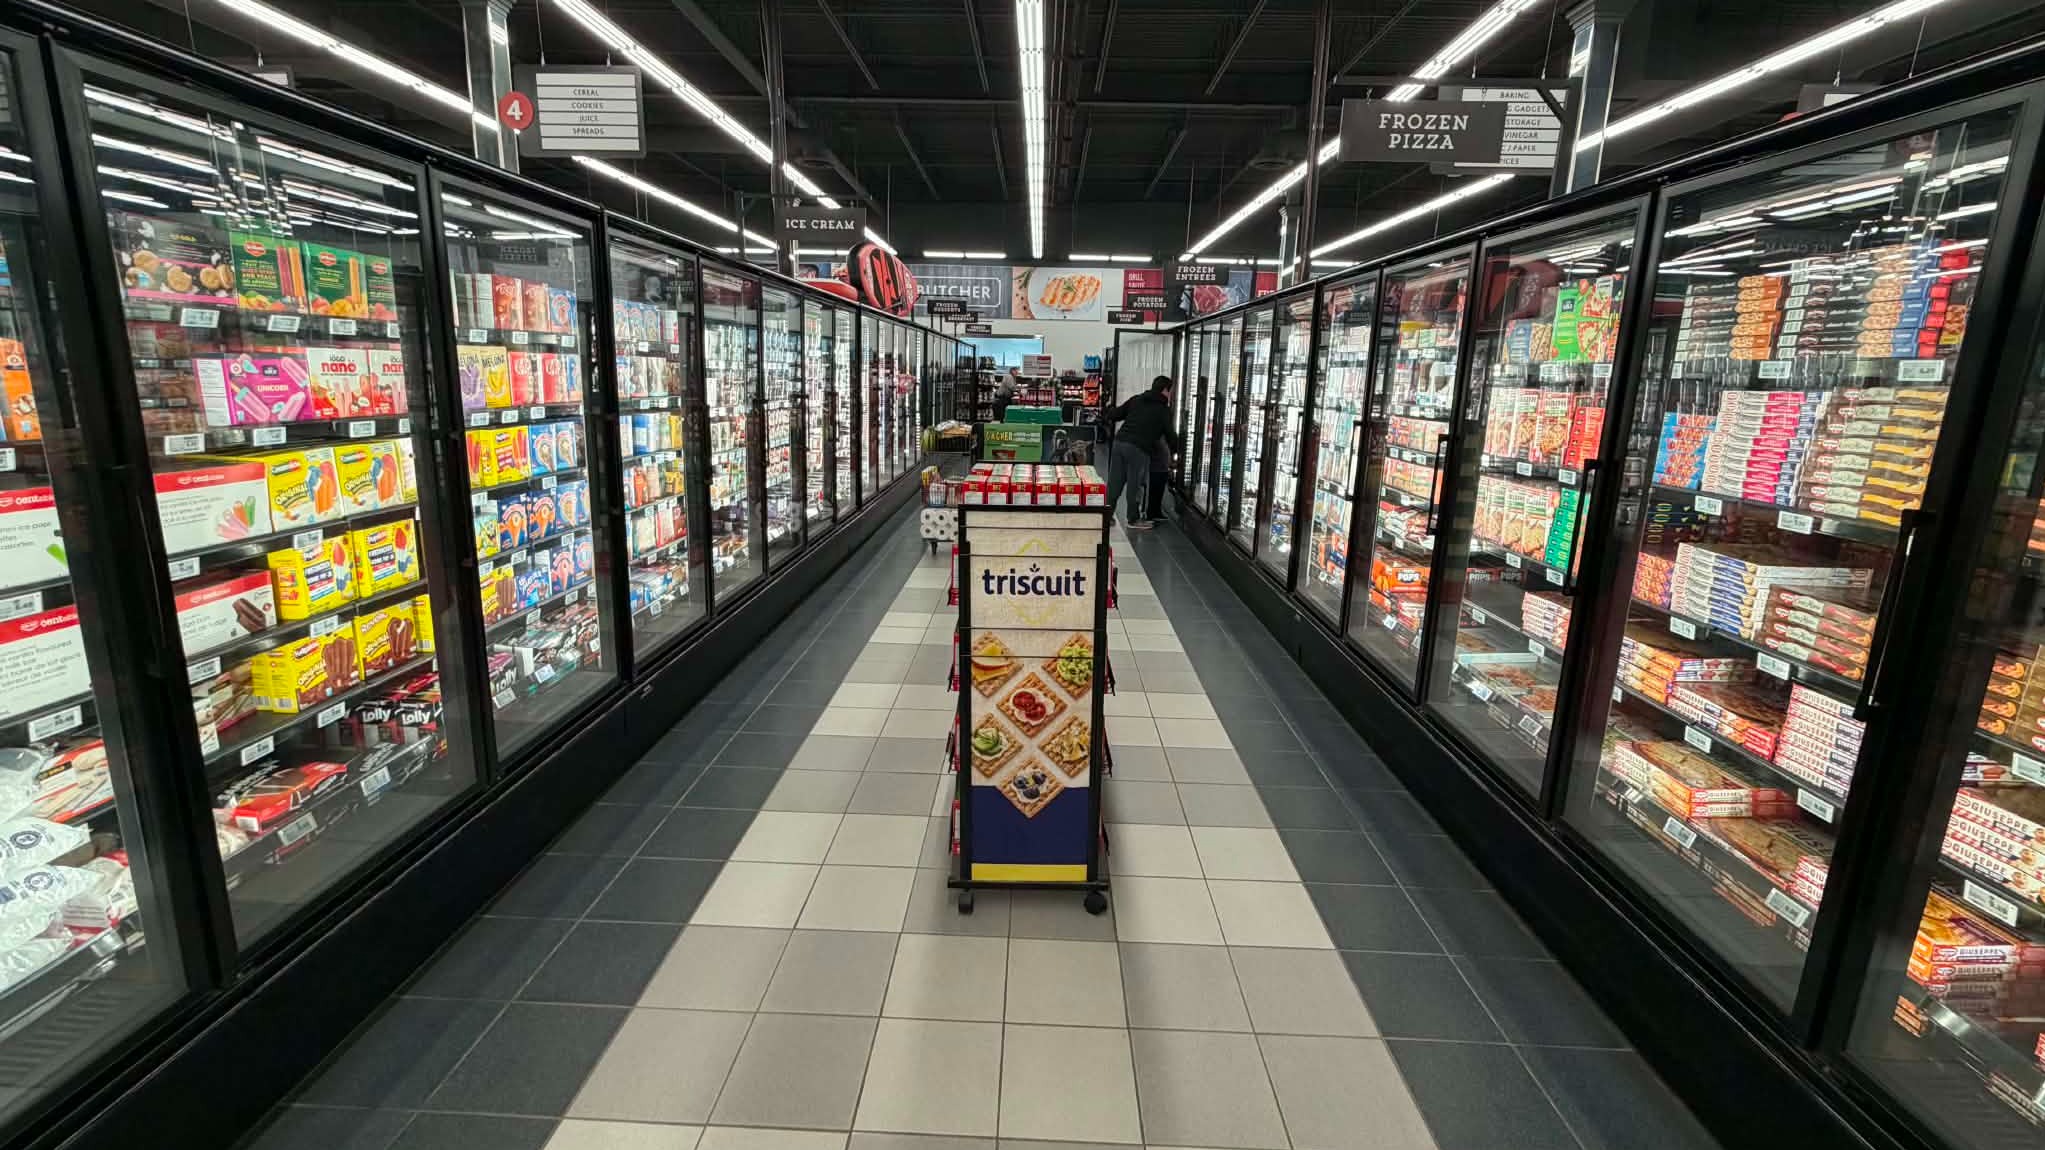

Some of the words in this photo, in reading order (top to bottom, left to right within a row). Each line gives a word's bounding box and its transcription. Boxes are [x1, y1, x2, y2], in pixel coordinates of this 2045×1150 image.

[572, 88, 600, 96] CEREAL
[1499, 91, 1529, 99] BAKING
[506, 99, 523, 121] 4
[571, 102, 604, 110] COOKIES
[1378, 113, 1469, 130] FROZEN
[572, 127, 605, 135] SPREADS
[1388, 133, 1455, 150] PIZZA
[785, 219, 807, 229] ICE
[811, 219, 855, 230] CREAM
[1177, 265, 1215, 274] FROZEN
[916, 285, 991, 299] BUTCHER
[982, 568, 1087, 596] triscuit
[362, 707, 391, 723] Lolly
[401, 710, 431, 726] Lolly
[1971, 801, 2029, 833] GIUSEPPE
[1959, 819, 2015, 852] GIUSEPPE
[1951, 840, 2007, 875] GIUSEPPE
